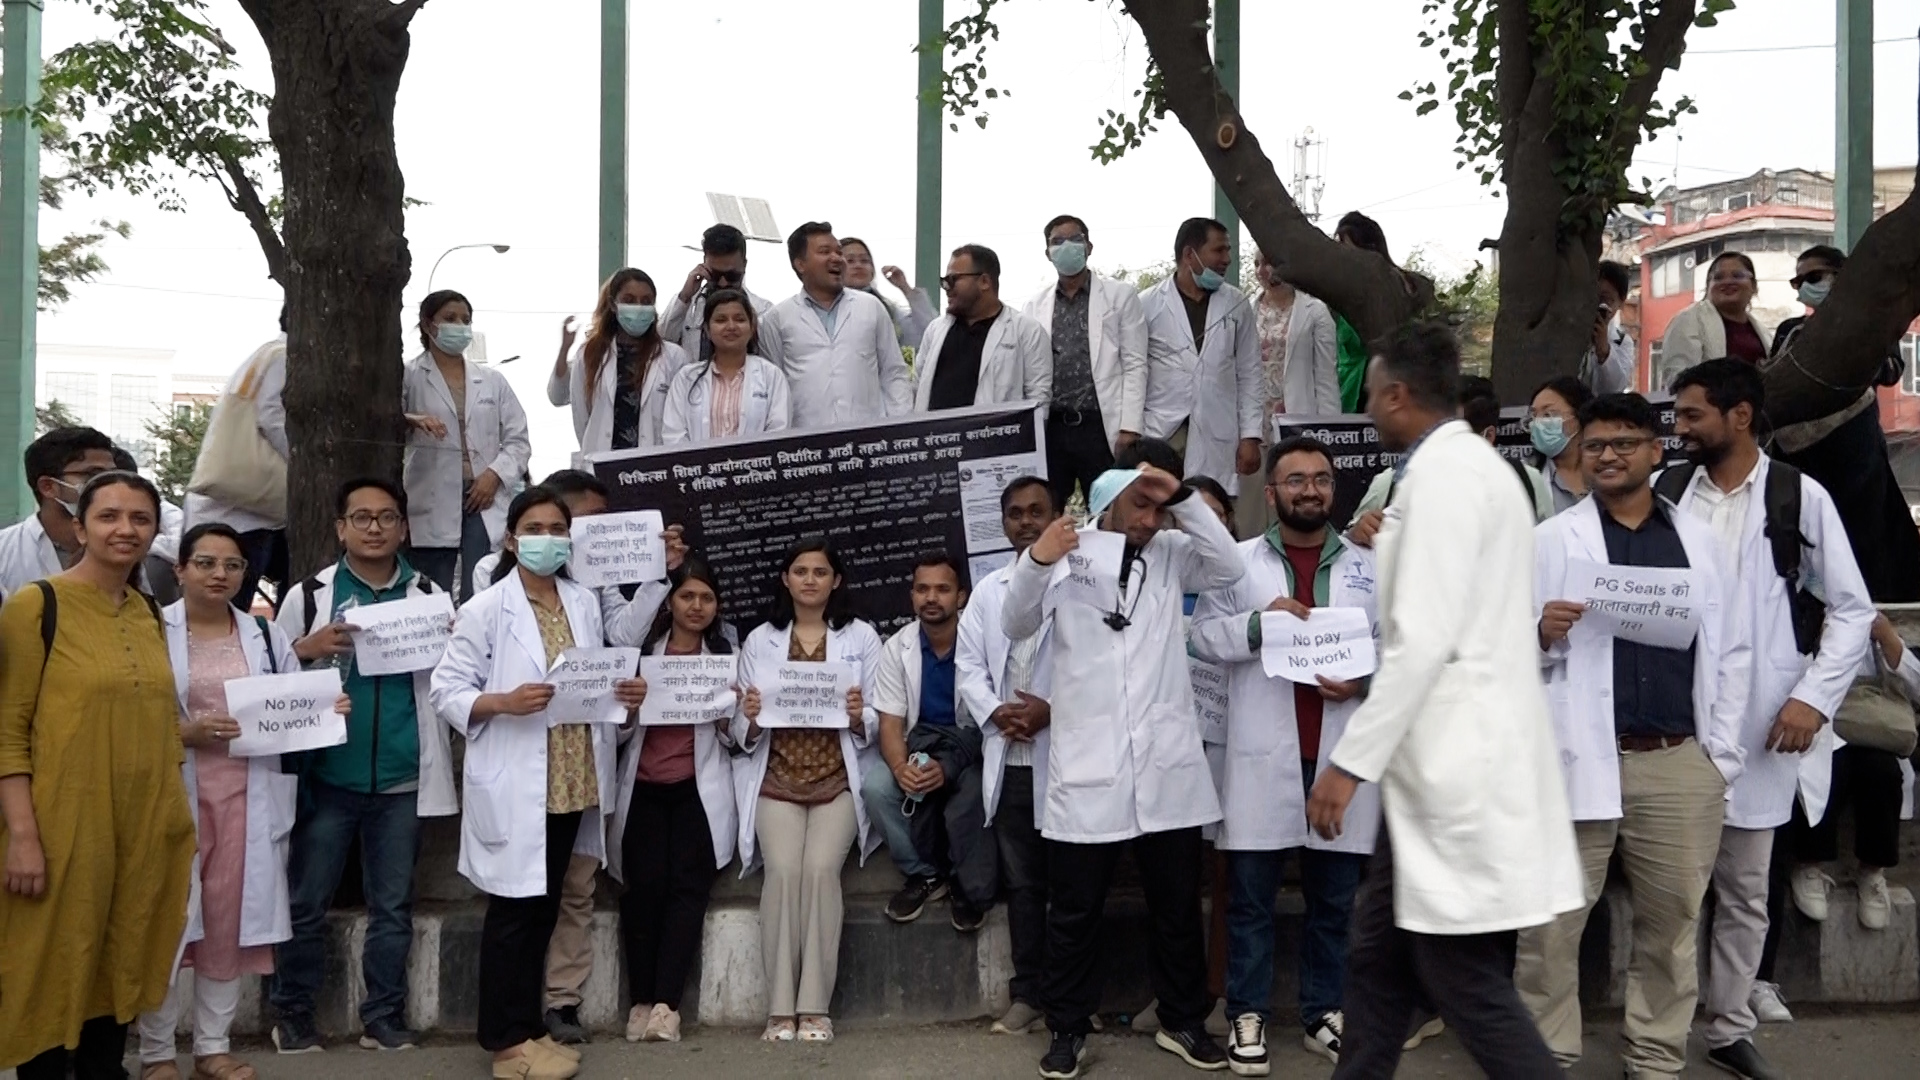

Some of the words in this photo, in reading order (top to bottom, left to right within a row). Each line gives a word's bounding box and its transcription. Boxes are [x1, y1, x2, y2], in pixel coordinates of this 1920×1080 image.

[837, 456, 865, 472] लागि
[618, 468, 668, 487] चिकित्सा
[672, 464, 702, 480] शिक्षा
[1594, 576, 1619, 592] PG
[1623, 582, 1666, 596] Seats
[1671, 580, 1690, 598] को
[1292, 634, 1311, 646] No
[1314, 632, 1341, 648] pay
[562, 660, 580, 672] PG
[1288, 655, 1308, 668] No
[1312, 648, 1352, 666] work!
[264, 698, 286, 712] No
[290, 697, 316, 714] pay
[258, 720, 280, 733] No
[284, 714, 321, 731] work!
